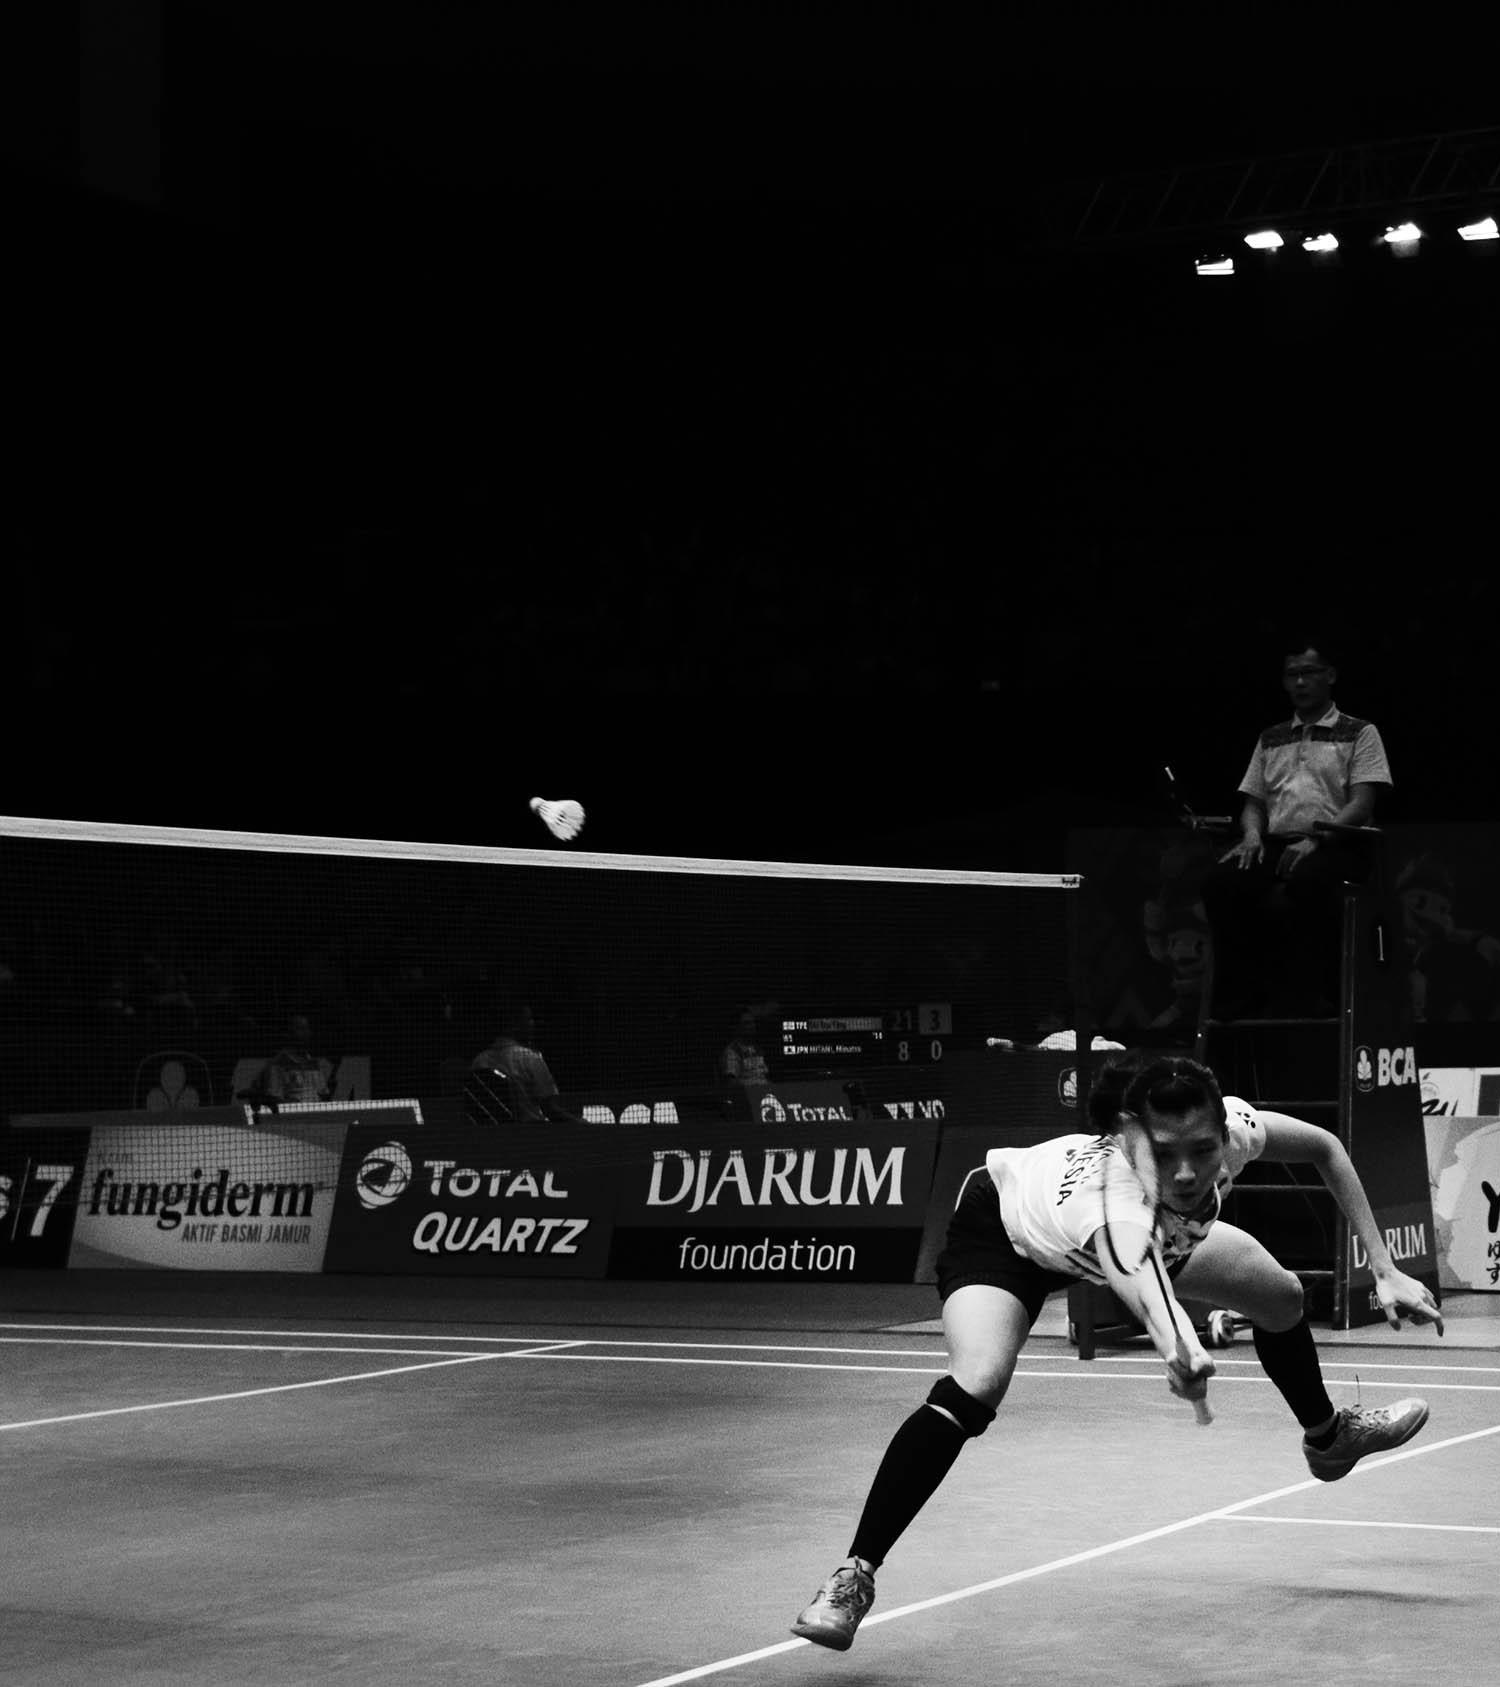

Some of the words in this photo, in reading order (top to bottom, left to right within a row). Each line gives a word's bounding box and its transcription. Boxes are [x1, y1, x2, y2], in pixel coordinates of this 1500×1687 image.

[930, 1009, 941, 1031] 3
[898, 1041, 909, 1061] 8
[931, 1040, 942, 1061] 0
[1378, 1046, 1417, 1086] BCA
[88, 1169, 314, 1230] fungiderm
[646, 1147, 906, 1213] DJARUM
[182, 1224, 218, 1243] AKTIF
[221, 1224, 262, 1244] BASMI
[266, 1224, 311, 1244] JAMUR
[411, 1211, 590, 1254] QUARTZ
[1352, 1223, 1427, 1270] DRUM
[678, 1236, 856, 1271] foundation
